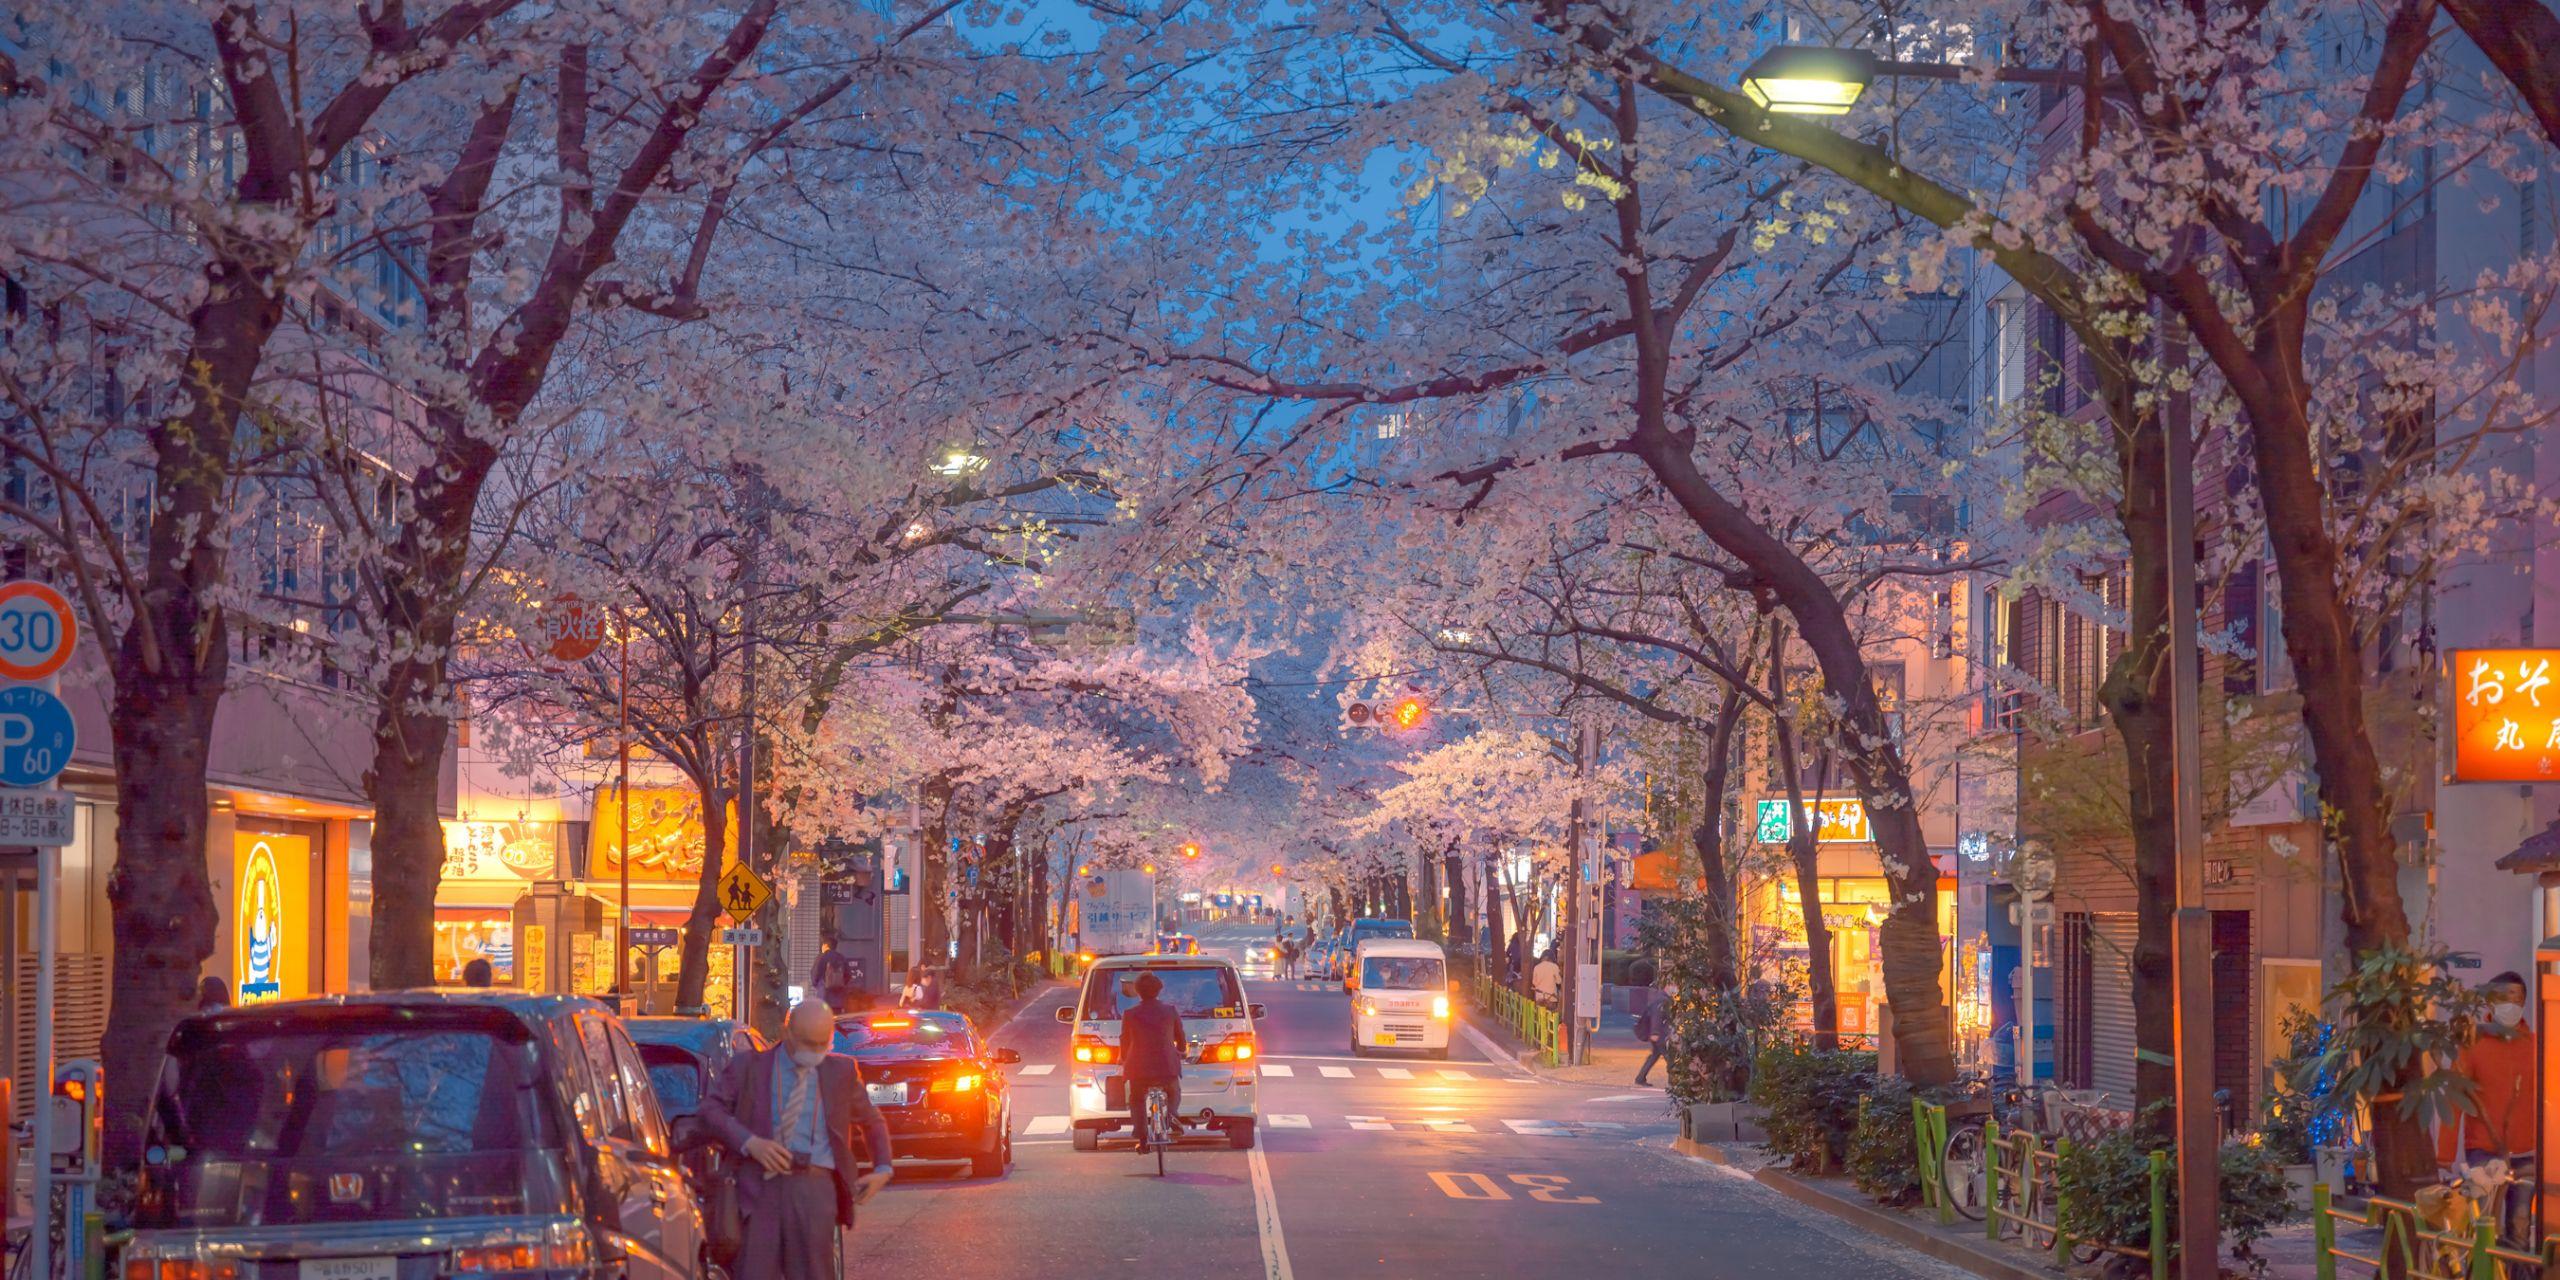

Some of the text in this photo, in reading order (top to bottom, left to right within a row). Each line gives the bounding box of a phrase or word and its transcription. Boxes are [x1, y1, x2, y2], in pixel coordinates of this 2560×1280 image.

[0, 610, 55, 653] 30
[0, 712, 34, 774] P
[23, 747, 52, 775] 60
[1427, 1171, 1603, 1204] 30
